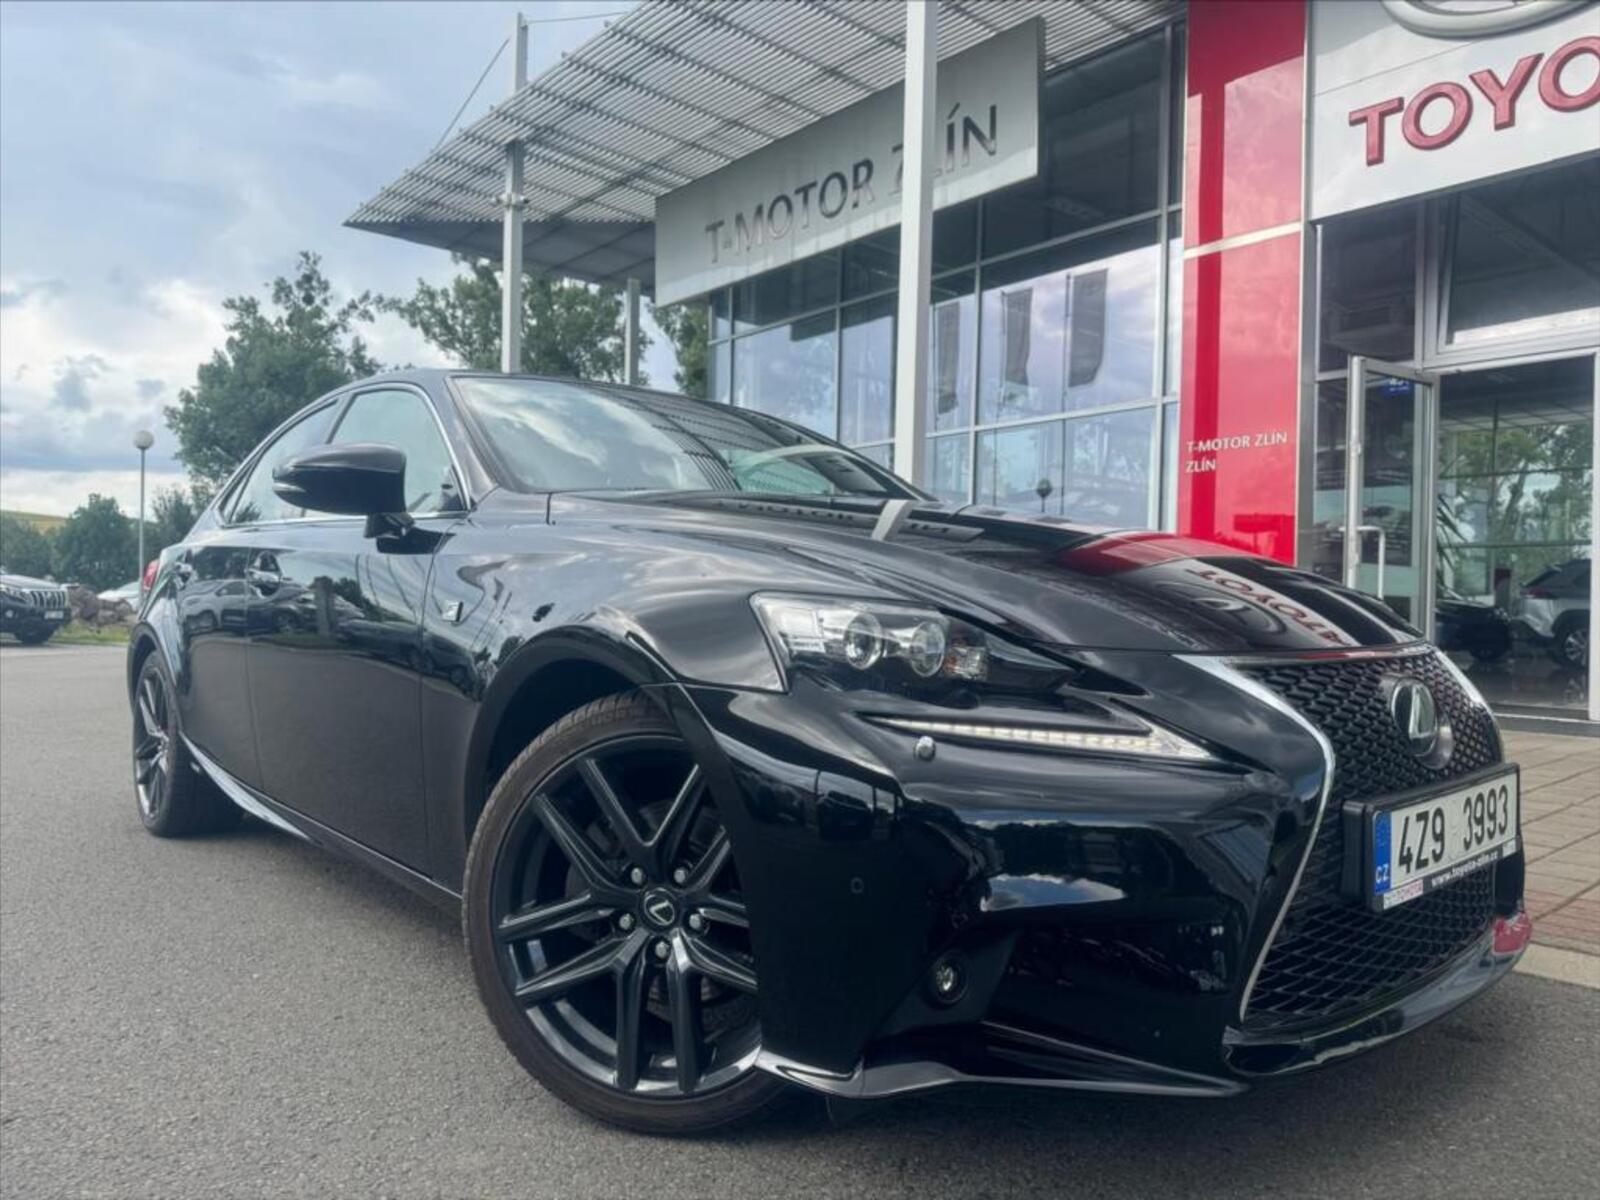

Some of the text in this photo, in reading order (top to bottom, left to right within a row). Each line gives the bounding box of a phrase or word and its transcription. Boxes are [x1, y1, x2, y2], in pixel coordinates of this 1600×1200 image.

[1349, 36, 1600, 166] TOYO
[705, 158, 875, 264] T-MOTOR
[1186, 435, 1250, 453] T-MOTOR
[1375, 863, 1390, 884] CZ
[1398, 785, 1508, 875] 4Z9 3993
